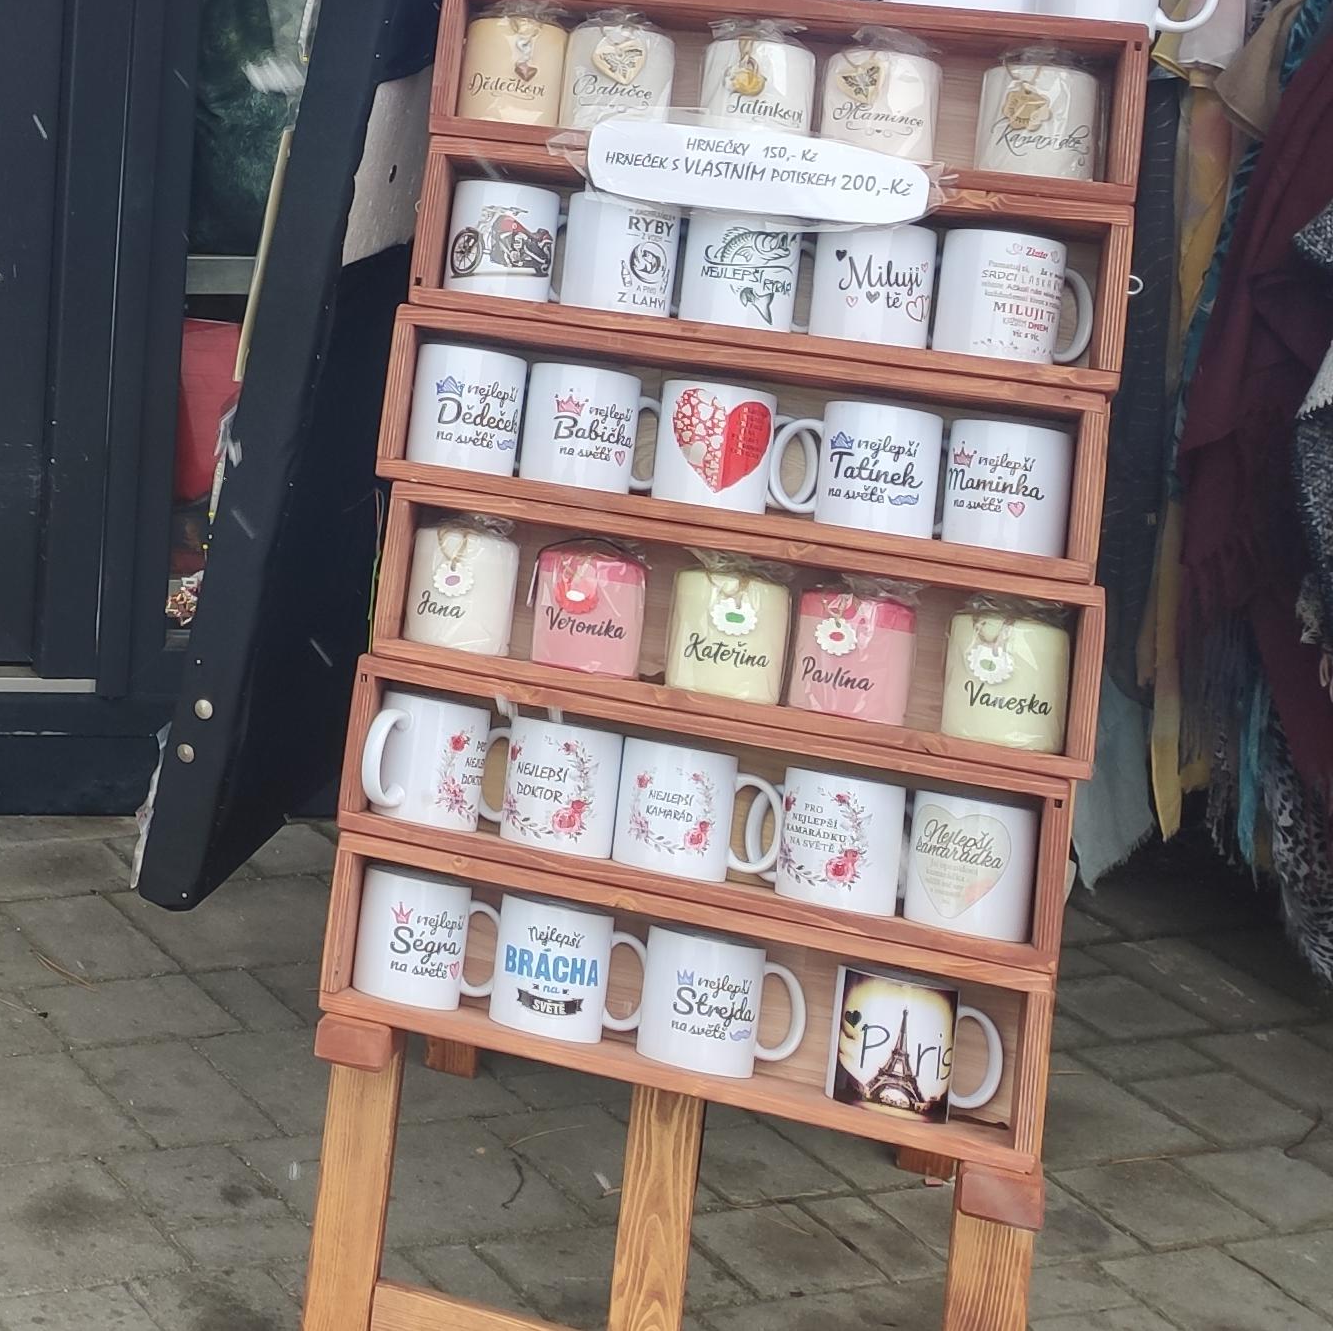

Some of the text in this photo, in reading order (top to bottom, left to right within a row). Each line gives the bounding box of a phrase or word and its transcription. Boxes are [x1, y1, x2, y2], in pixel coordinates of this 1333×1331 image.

[467, 72, 547, 98] Dědečkovi
[573, 74, 654, 100] Babičce
[833, 101, 924, 127] Mamince
[606, 151, 667, 170] HRNEČEK
[672, 159, 679, 170] S
[684, 157, 767, 181] VLASTNÍM
[771, 169, 836, 187] POTISKEM
[628, 216, 674, 236] RYBY
[701, 265, 764, 283] NEJLEPŠÍ
[839, 254, 923, 296] Miluji
[887, 291, 903, 309] tě
[467, 381, 519, 407] nejlepší
[437, 397, 519, 434] Dědeček
[589, 404, 633, 426] nejlepší
[436, 431, 496, 449] na světě
[554, 415, 633, 448] Babička
[559, 446, 612, 462] na světě
[857, 435, 920, 462] nejlepší
[830, 451, 923, 489] Tatínek
[978, 453, 1036, 475] nejlepší
[828, 485, 886, 503] na světě
[948, 468, 1045, 500] Maminka
[954, 497, 1004, 513] na světě
[417, 588, 466, 622] Jana
[545, 605, 628, 642] Veronika
[684, 633, 770, 670] Kateřina
[802, 655, 875, 694] Pavlína
[517, 761, 570, 783] NEJLEPŠÍ
[516, 781, 563, 804] DOKTOR
[648, 789, 696, 806] NEJLEPŠÍ
[646, 804, 693, 823] KAMARÁD
[804, 802, 824, 813] PRO
[792, 812, 838, 829] NEJLEPŠÍ
[786, 823, 846, 843] KAMARÁDKU
[790, 836, 835, 853] NA SVĚTĚ
[924, 819, 993, 852] Nejlepší
[916, 836, 1003, 869] kamarádka
[417, 911, 465, 938] nejlepší
[390, 926, 461, 965] Ségra
[528, 926, 585, 949] Nejlepší
[390, 960, 449, 980] na světě
[505, 944, 598, 987] BRÁCHA
[543, 984, 559, 994] na
[698, 974, 753, 1001] nejlepší
[532, 998, 566, 1015] SVĚTĚ
[673, 986, 755, 1029] Strejda
[671, 1020, 729, 1041] na světě
